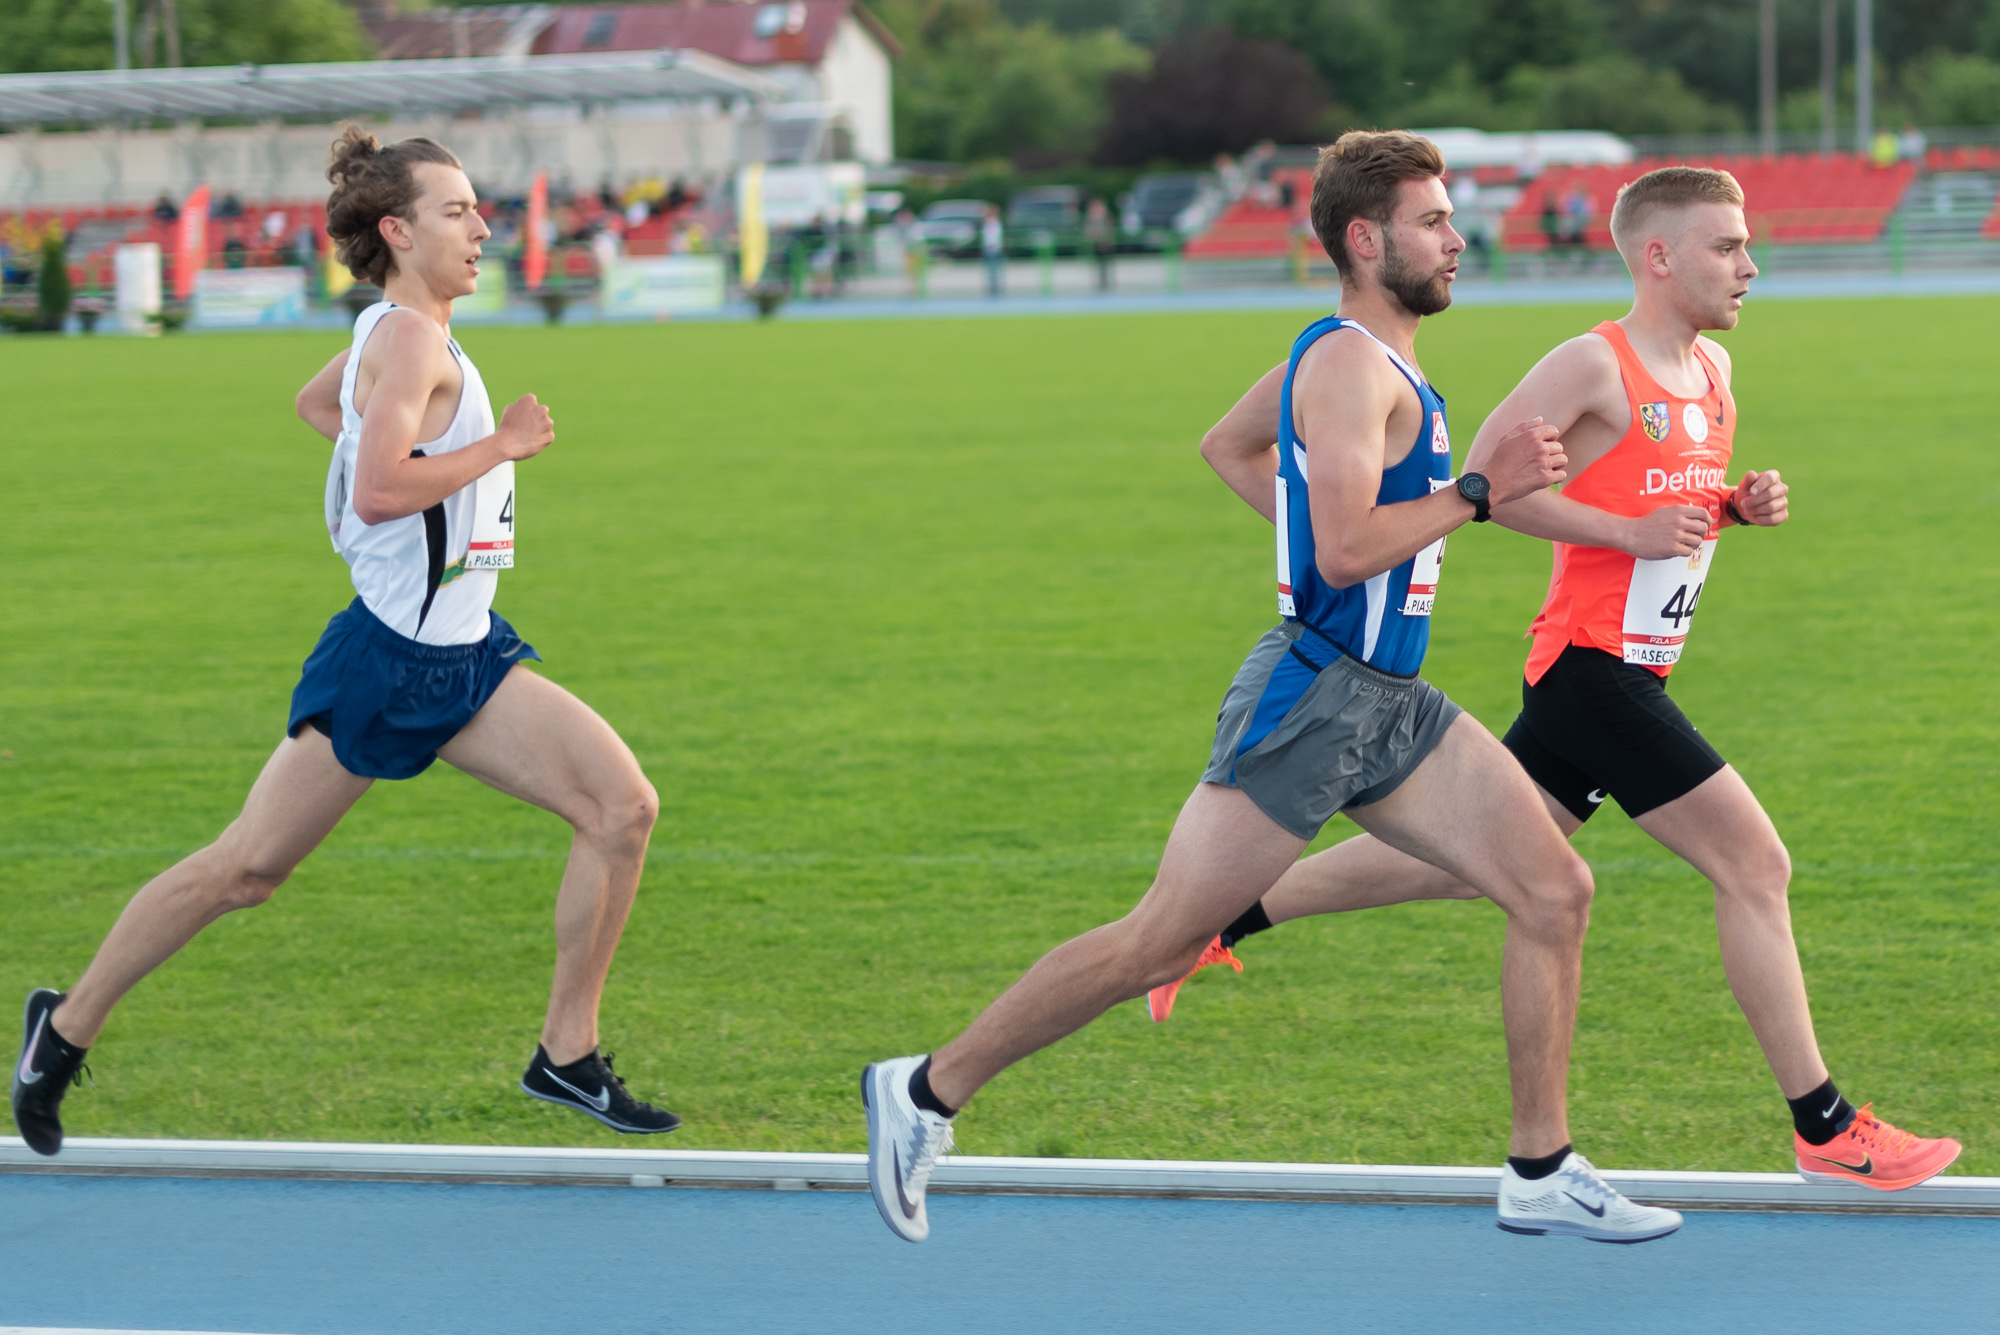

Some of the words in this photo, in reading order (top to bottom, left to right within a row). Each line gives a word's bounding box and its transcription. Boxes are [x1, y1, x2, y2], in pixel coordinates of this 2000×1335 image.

[1660, 583, 1702, 628] 44
[1649, 636, 1670, 645] PZLA
[1631, 647, 1682, 663] PIASECZN
